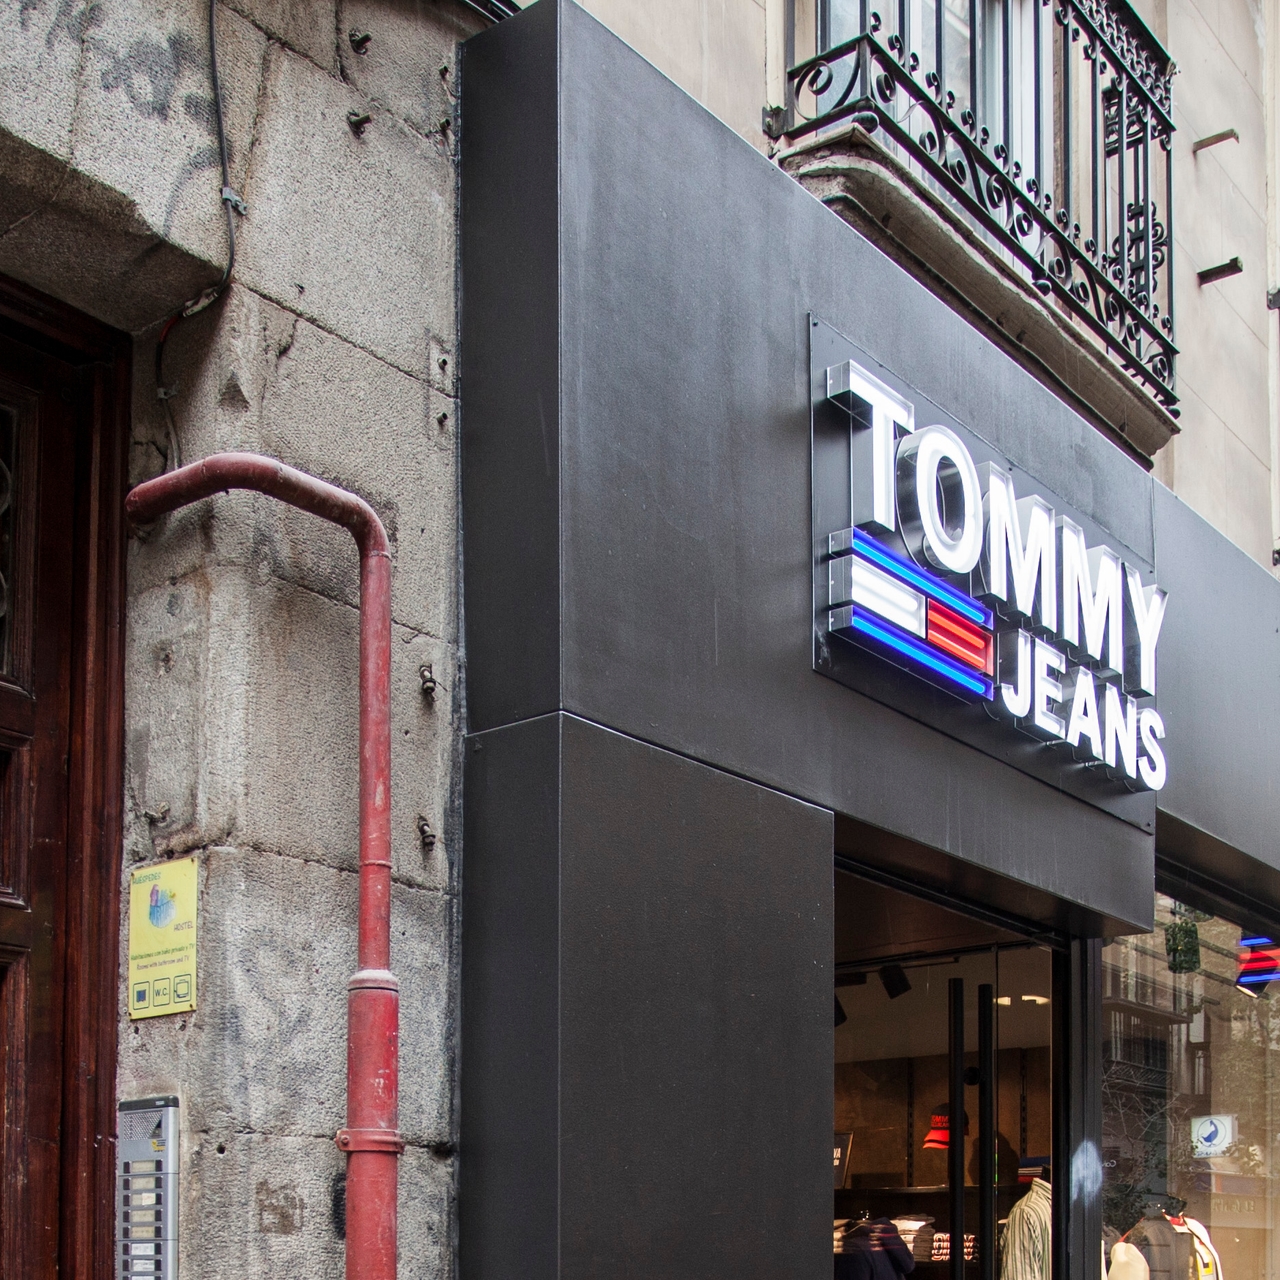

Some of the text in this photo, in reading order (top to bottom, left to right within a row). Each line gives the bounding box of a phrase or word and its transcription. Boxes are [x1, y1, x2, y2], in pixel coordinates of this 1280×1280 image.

[846, 359, 1169, 697] TOMMY
[1000, 628, 1167, 791] JEANS
[174, 920, 194, 932] HOSTEL
